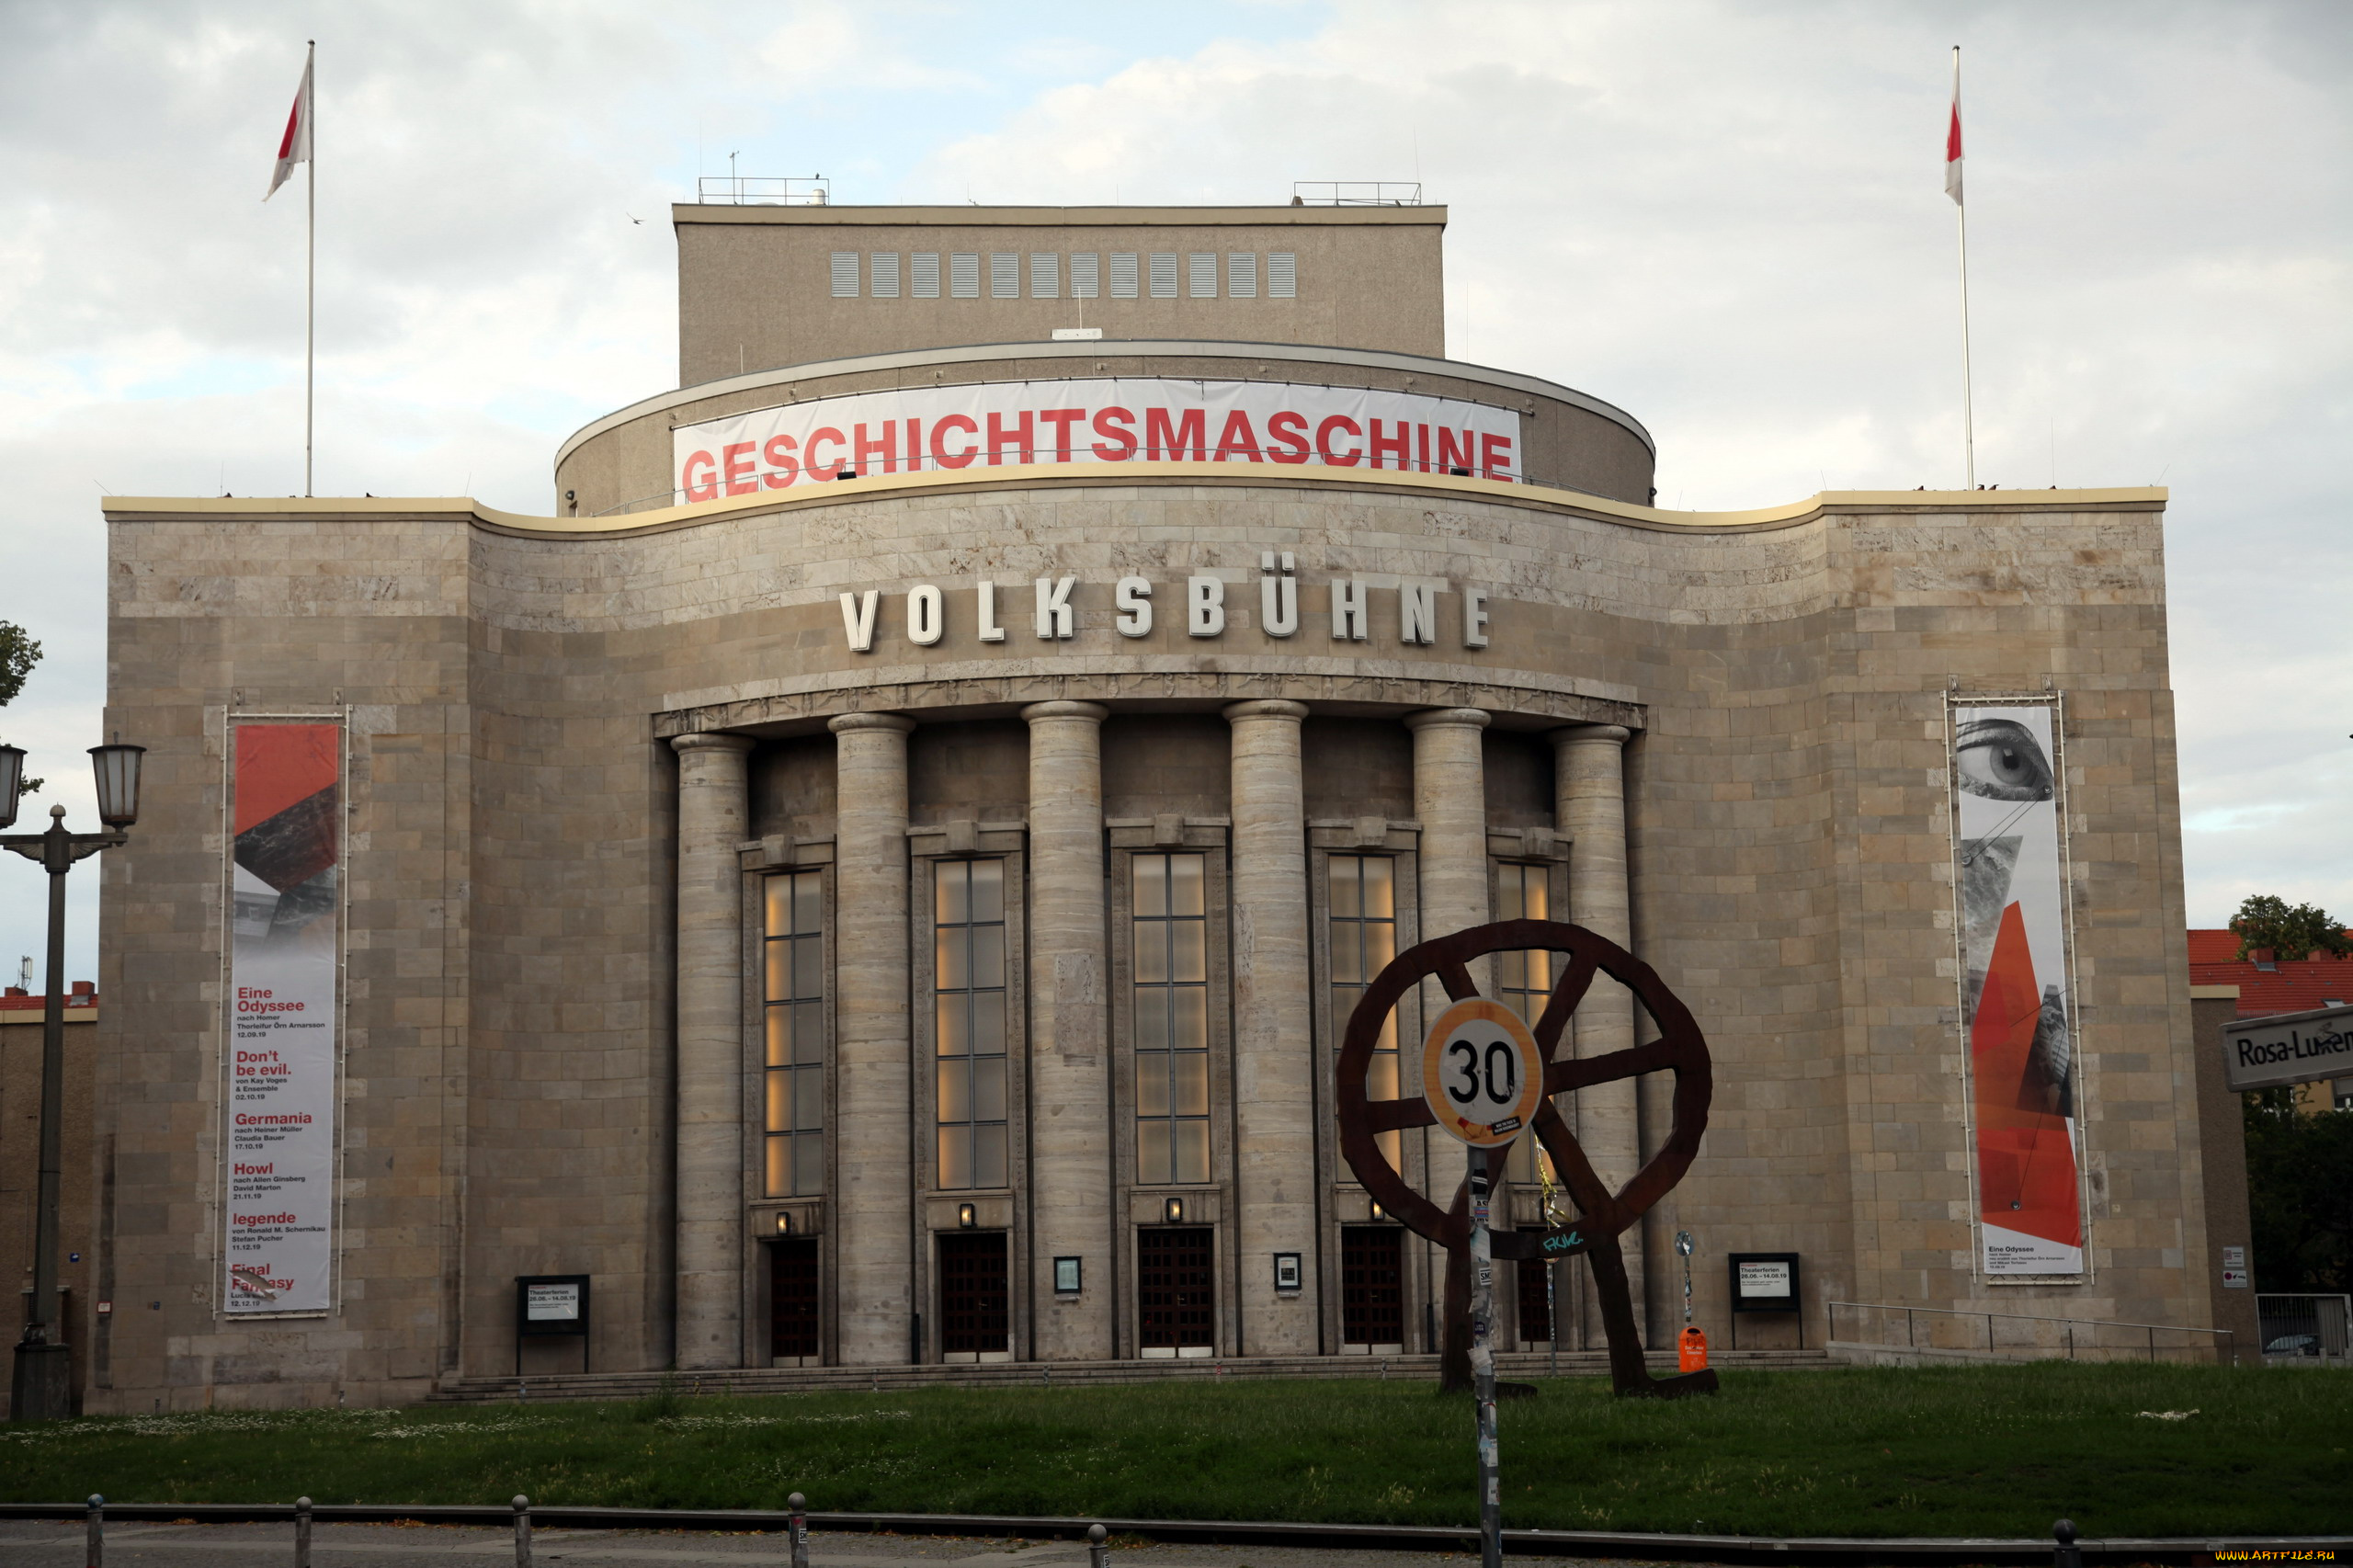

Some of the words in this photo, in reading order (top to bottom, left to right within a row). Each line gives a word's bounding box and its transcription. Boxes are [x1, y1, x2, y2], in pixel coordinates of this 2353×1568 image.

[682, 406, 1513, 503] GESCHICHTSMASCHINE
[838, 551, 1488, 651] VOLKSBÜHNE
[237, 987, 273, 999] Eine
[237, 1001, 305, 1015] Odyssee
[236, 1050, 279, 1062] Don't
[236, 1064, 256, 1076] be
[259, 1063, 291, 1075] evil.
[1449, 1040, 1516, 1105] 30
[235, 1112, 313, 1125] Germania
[233, 1163, 273, 1175] Howl
[233, 1211, 296, 1227] legende
